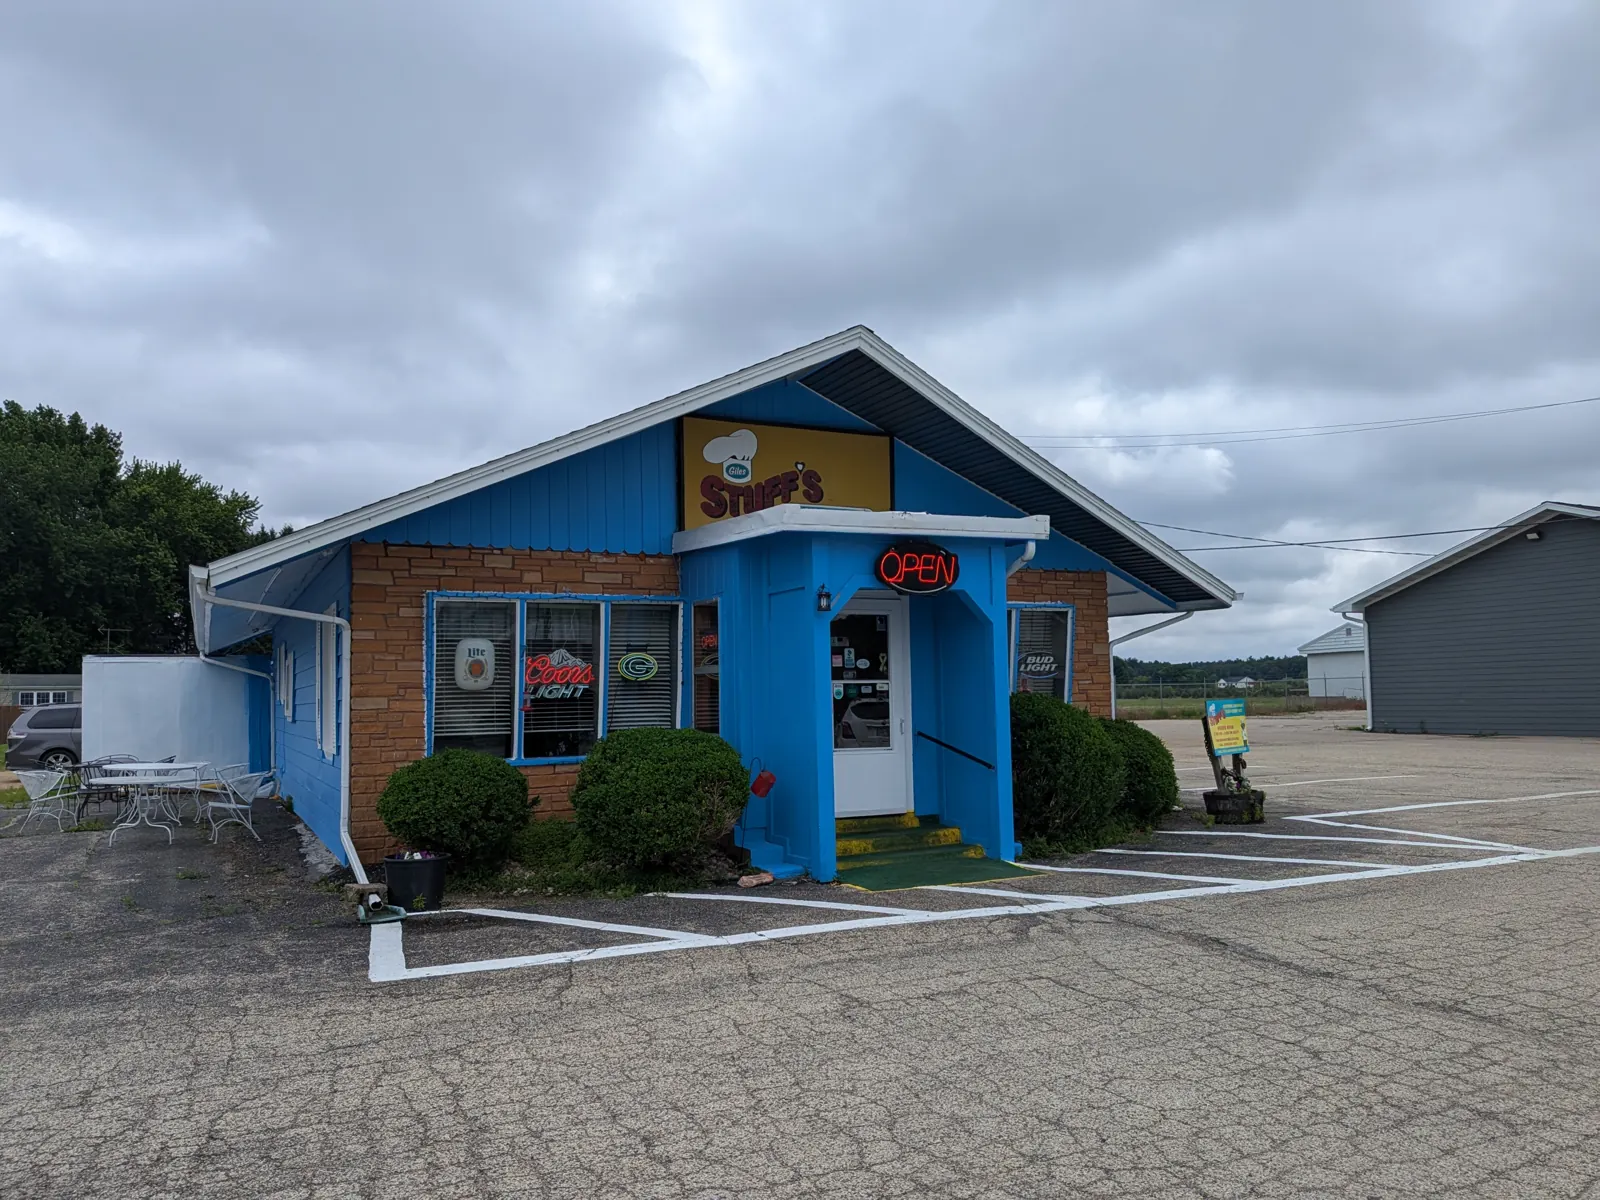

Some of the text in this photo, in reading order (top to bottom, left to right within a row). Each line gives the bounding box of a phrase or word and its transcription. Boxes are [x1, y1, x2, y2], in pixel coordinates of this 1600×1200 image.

[728, 466, 747, 476] Giles
[880, 551, 956, 584] OPEN
[467, 647, 486, 659] Lite
[1026, 656, 1054, 664] BUD
[525, 654, 595, 684] Coors
[1019, 663, 1059, 672] LIGHT
[527, 683, 590, 699] LIGHT
